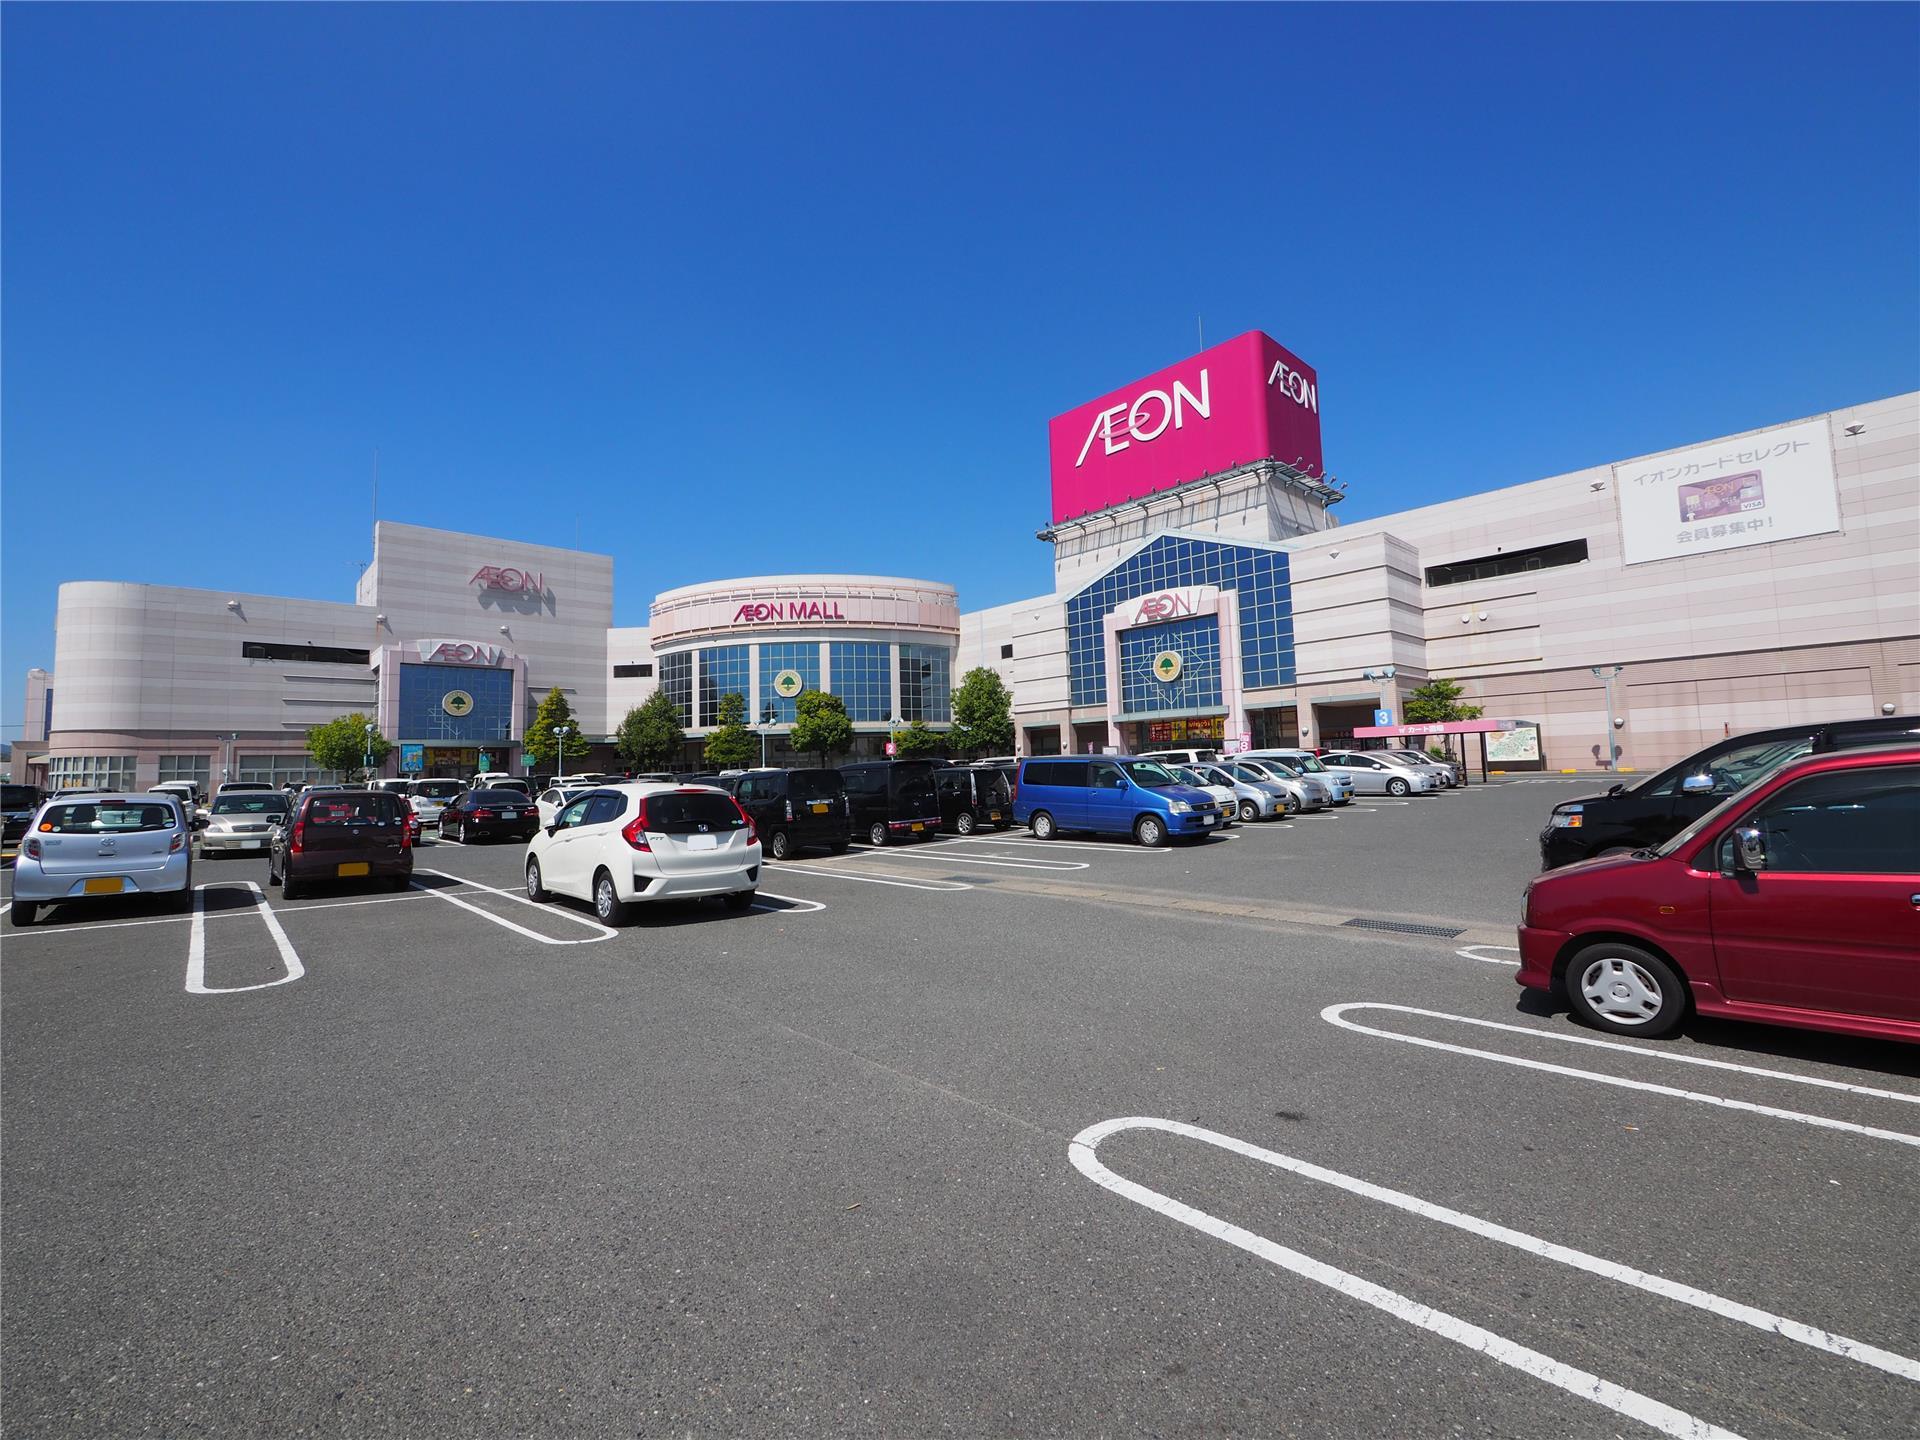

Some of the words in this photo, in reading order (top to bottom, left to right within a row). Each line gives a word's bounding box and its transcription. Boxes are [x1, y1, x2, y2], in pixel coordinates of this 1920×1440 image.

[1634, 441, 1810, 486] イオンカードセレクト
[1743, 501, 1762, 509] VISA
[789, 601, 845, 620] MALL
[1379, 711, 1389, 725] 3
